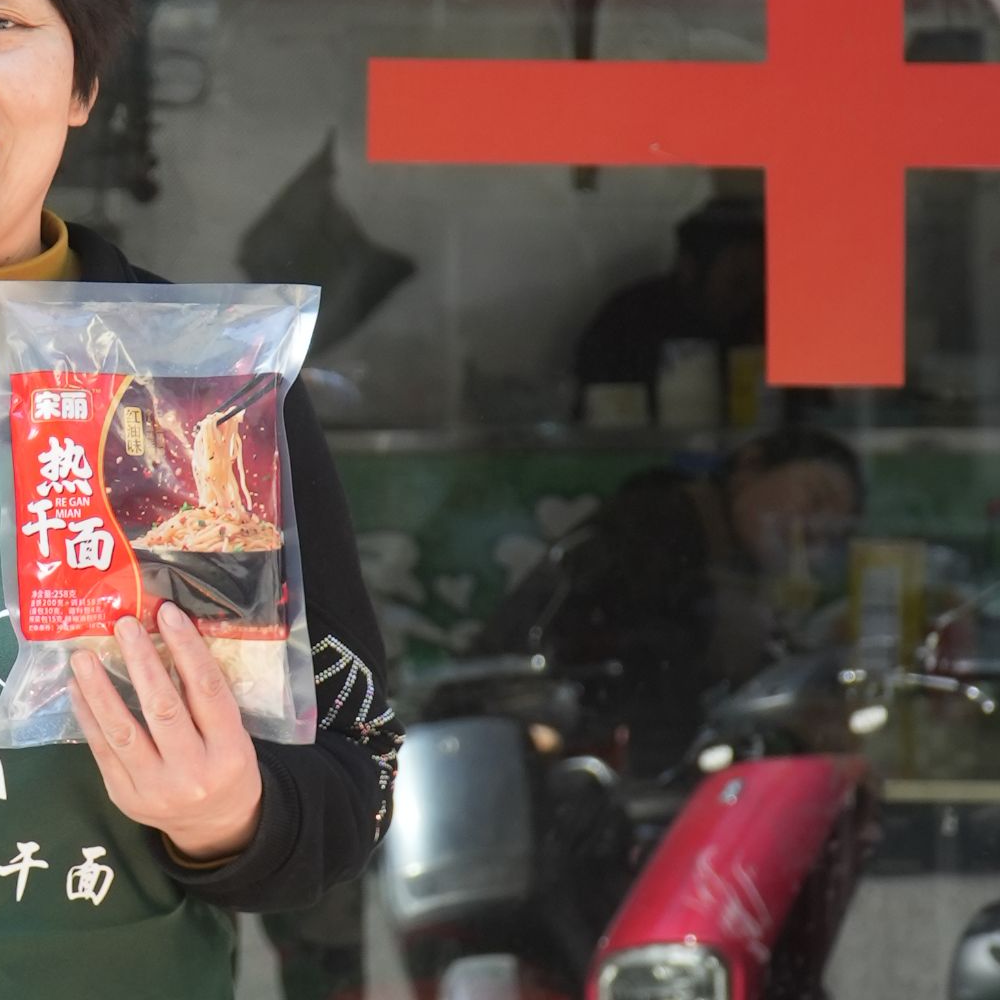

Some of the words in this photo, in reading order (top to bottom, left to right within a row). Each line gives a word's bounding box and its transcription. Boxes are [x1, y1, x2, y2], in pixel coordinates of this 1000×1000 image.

[34, 391, 88, 420] 宋丽
[55, 497, 67, 507] RE
[69, 496, 91, 507] GAN
[55, 508, 82, 519] MIAN
